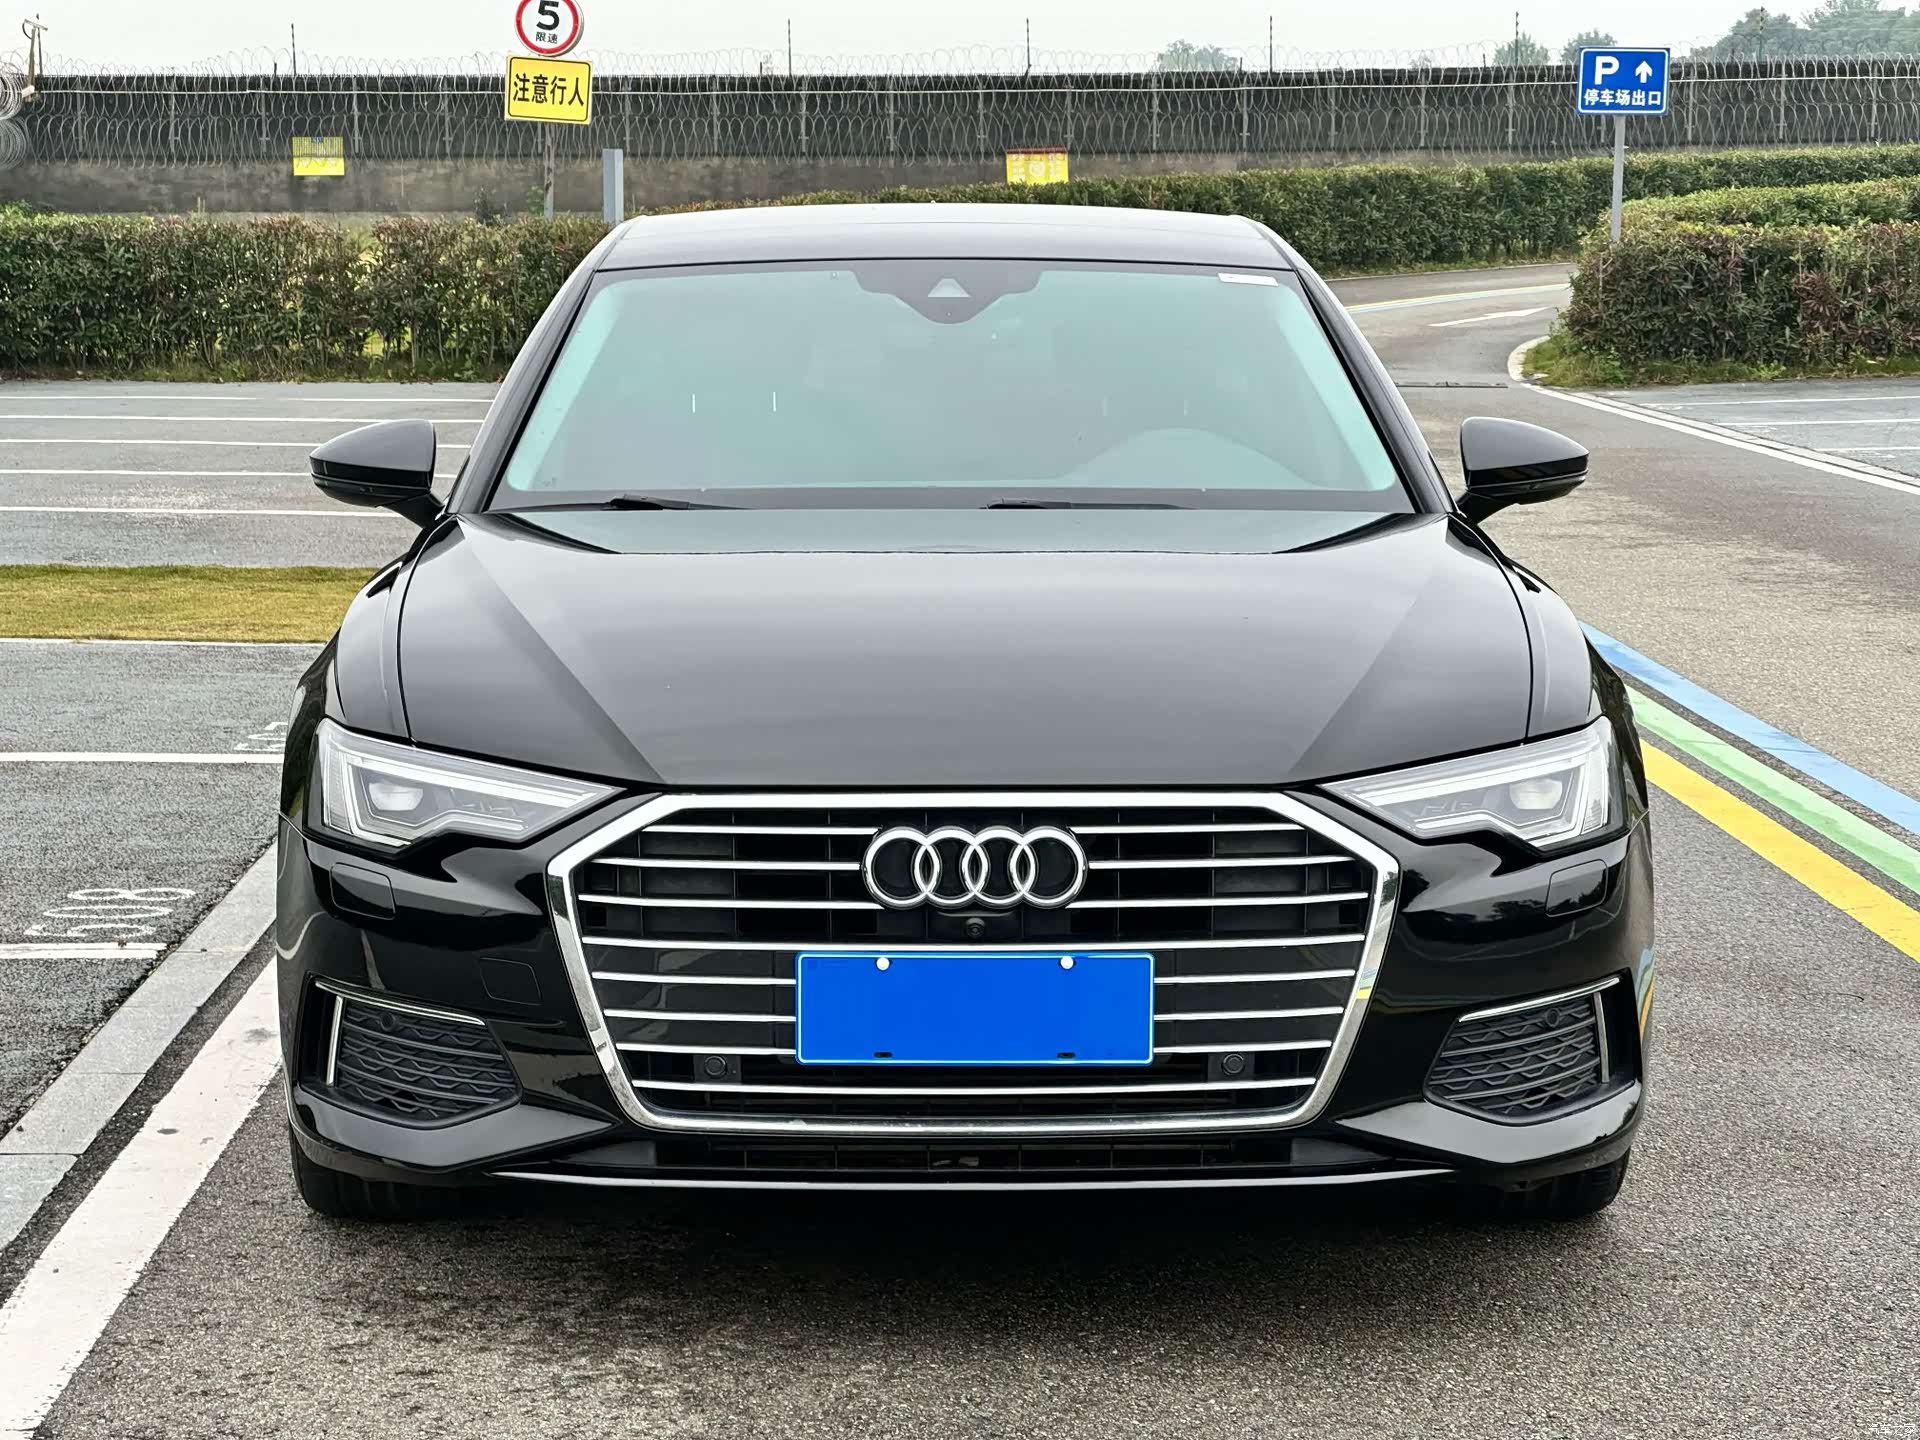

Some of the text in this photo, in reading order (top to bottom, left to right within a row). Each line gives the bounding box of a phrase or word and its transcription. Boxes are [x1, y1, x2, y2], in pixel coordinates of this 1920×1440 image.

[536, 0, 560, 31] 5
[535, 31, 558, 44] 限速
[1594, 56, 1620, 85] P
[513, 73, 584, 106] 注意行人
[1584, 88, 1661, 106] 停车场出口
